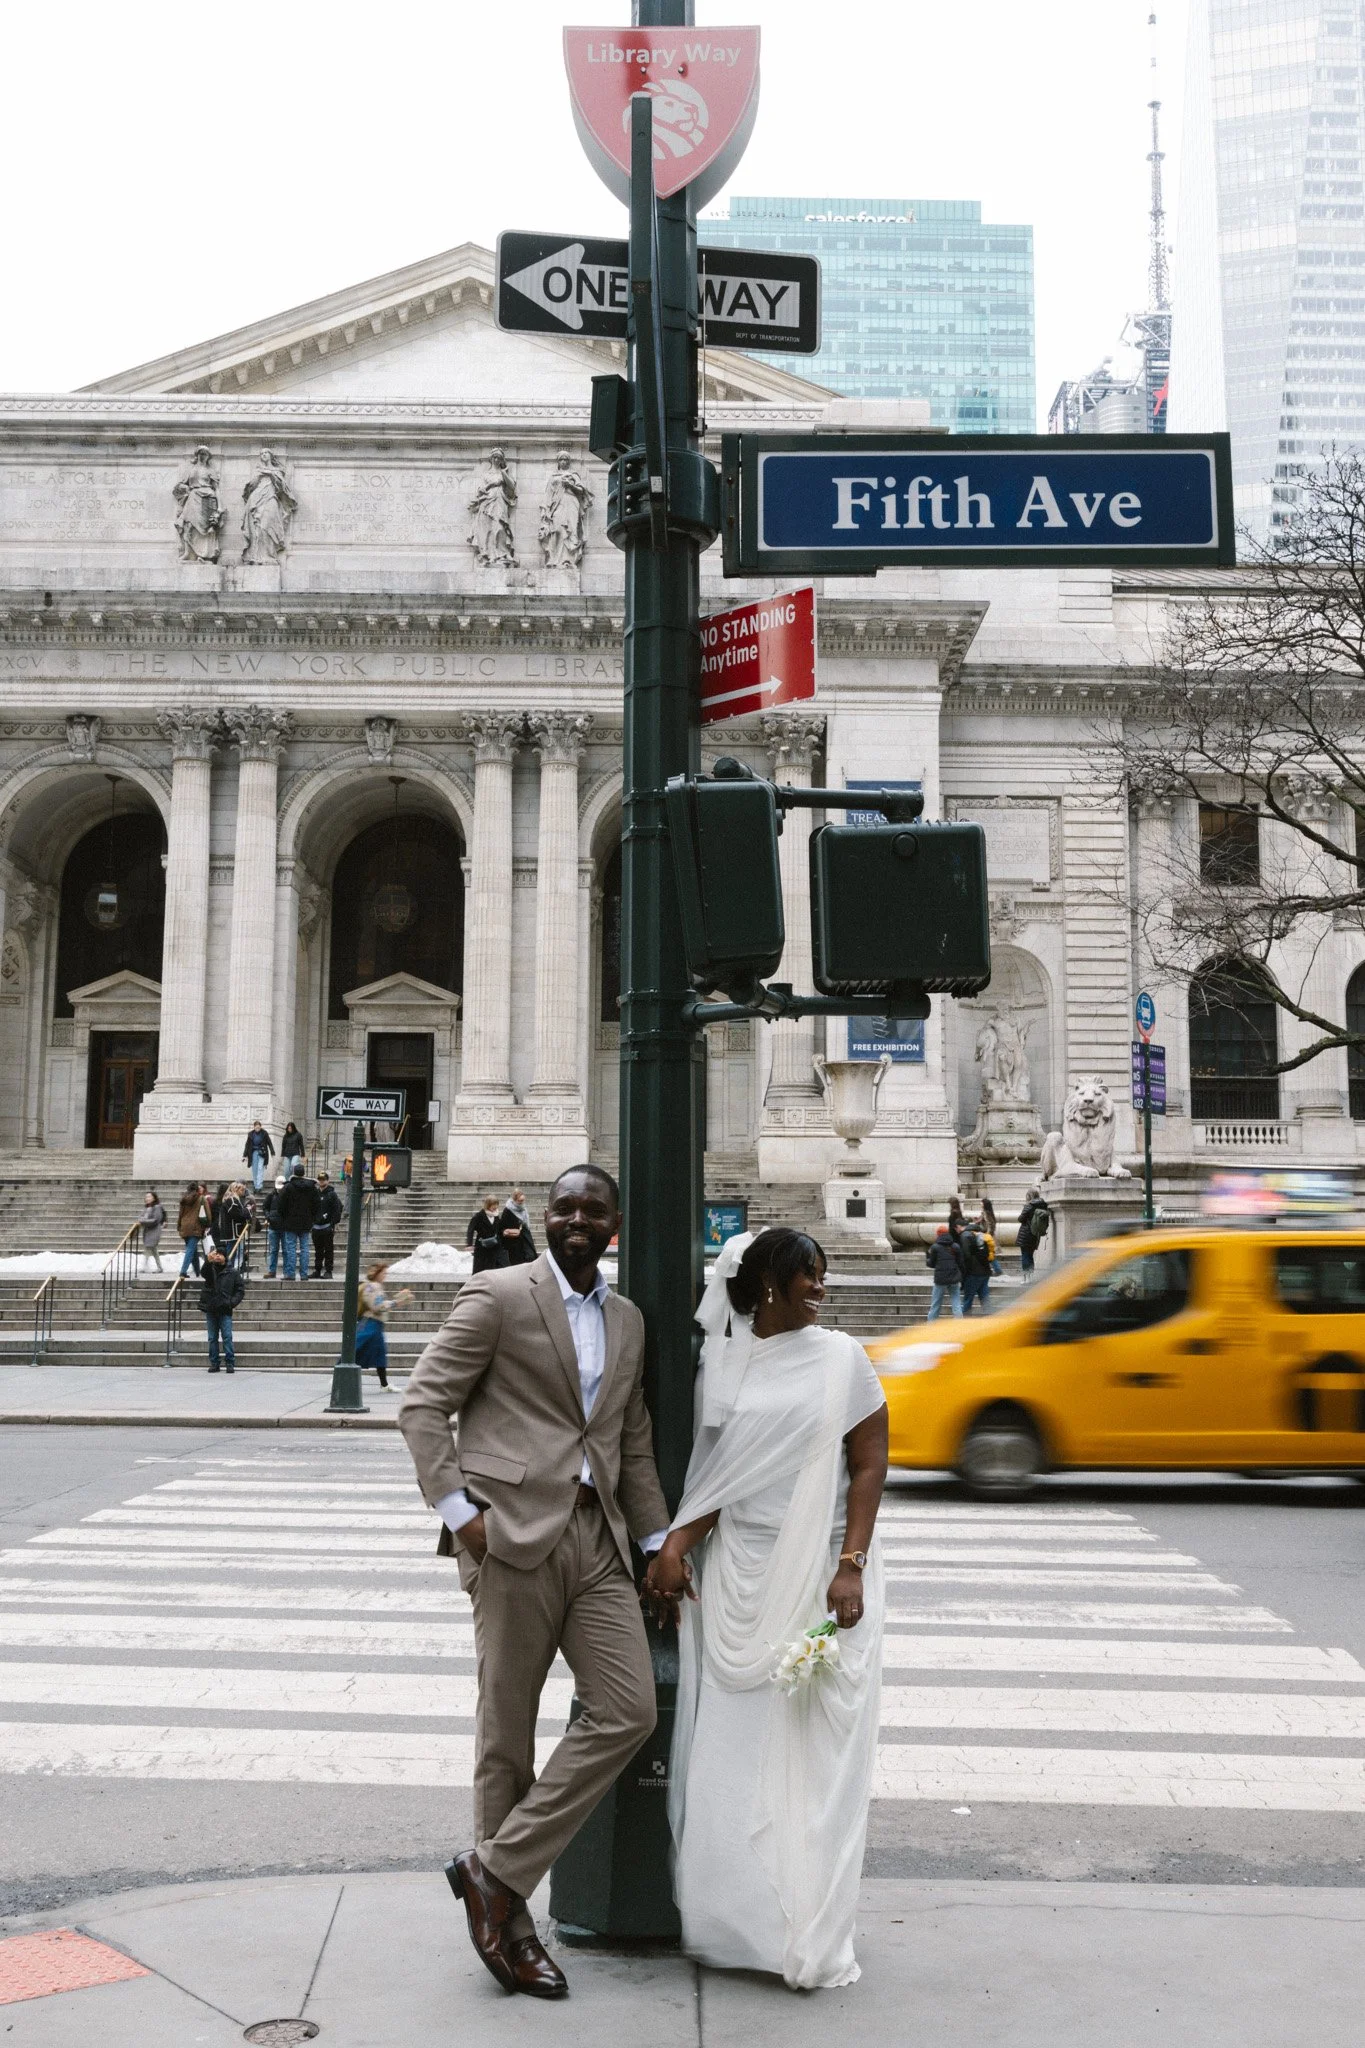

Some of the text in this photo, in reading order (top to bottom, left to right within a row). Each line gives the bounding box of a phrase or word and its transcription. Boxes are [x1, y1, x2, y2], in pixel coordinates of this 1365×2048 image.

[587, 43, 741, 68] Library Way
[543, 266, 790, 320] ONE WAY
[760, 334, 800, 343] TRANSPORTATION
[7, 471, 169, 485] THE ASTOR LIBRARY
[342, 474, 392, 489] LENOX
[401, 475, 466, 490] LIBRARY
[63, 499, 101, 510] JACOB
[109, 499, 145, 510] ASTOR
[338, 502, 428, 513] JAMES LENOX
[832, 475, 1143, 529] Fifth Ave
[323, 513, 375, 523] DEDICATED
[299, 523, 359, 533] LITERATURE
[699, 603, 796, 648] NO STANDING
[0, 653, 625, 678] XCV THE NEW YORK PUBLIC LIBRAR
[700, 644, 759, 674] Anytime
[850, 812, 888, 824] TREAS
[852, 1043, 920, 1052] FREE EXHIBITION
[334, 1098, 390, 1111] ONE WAY
